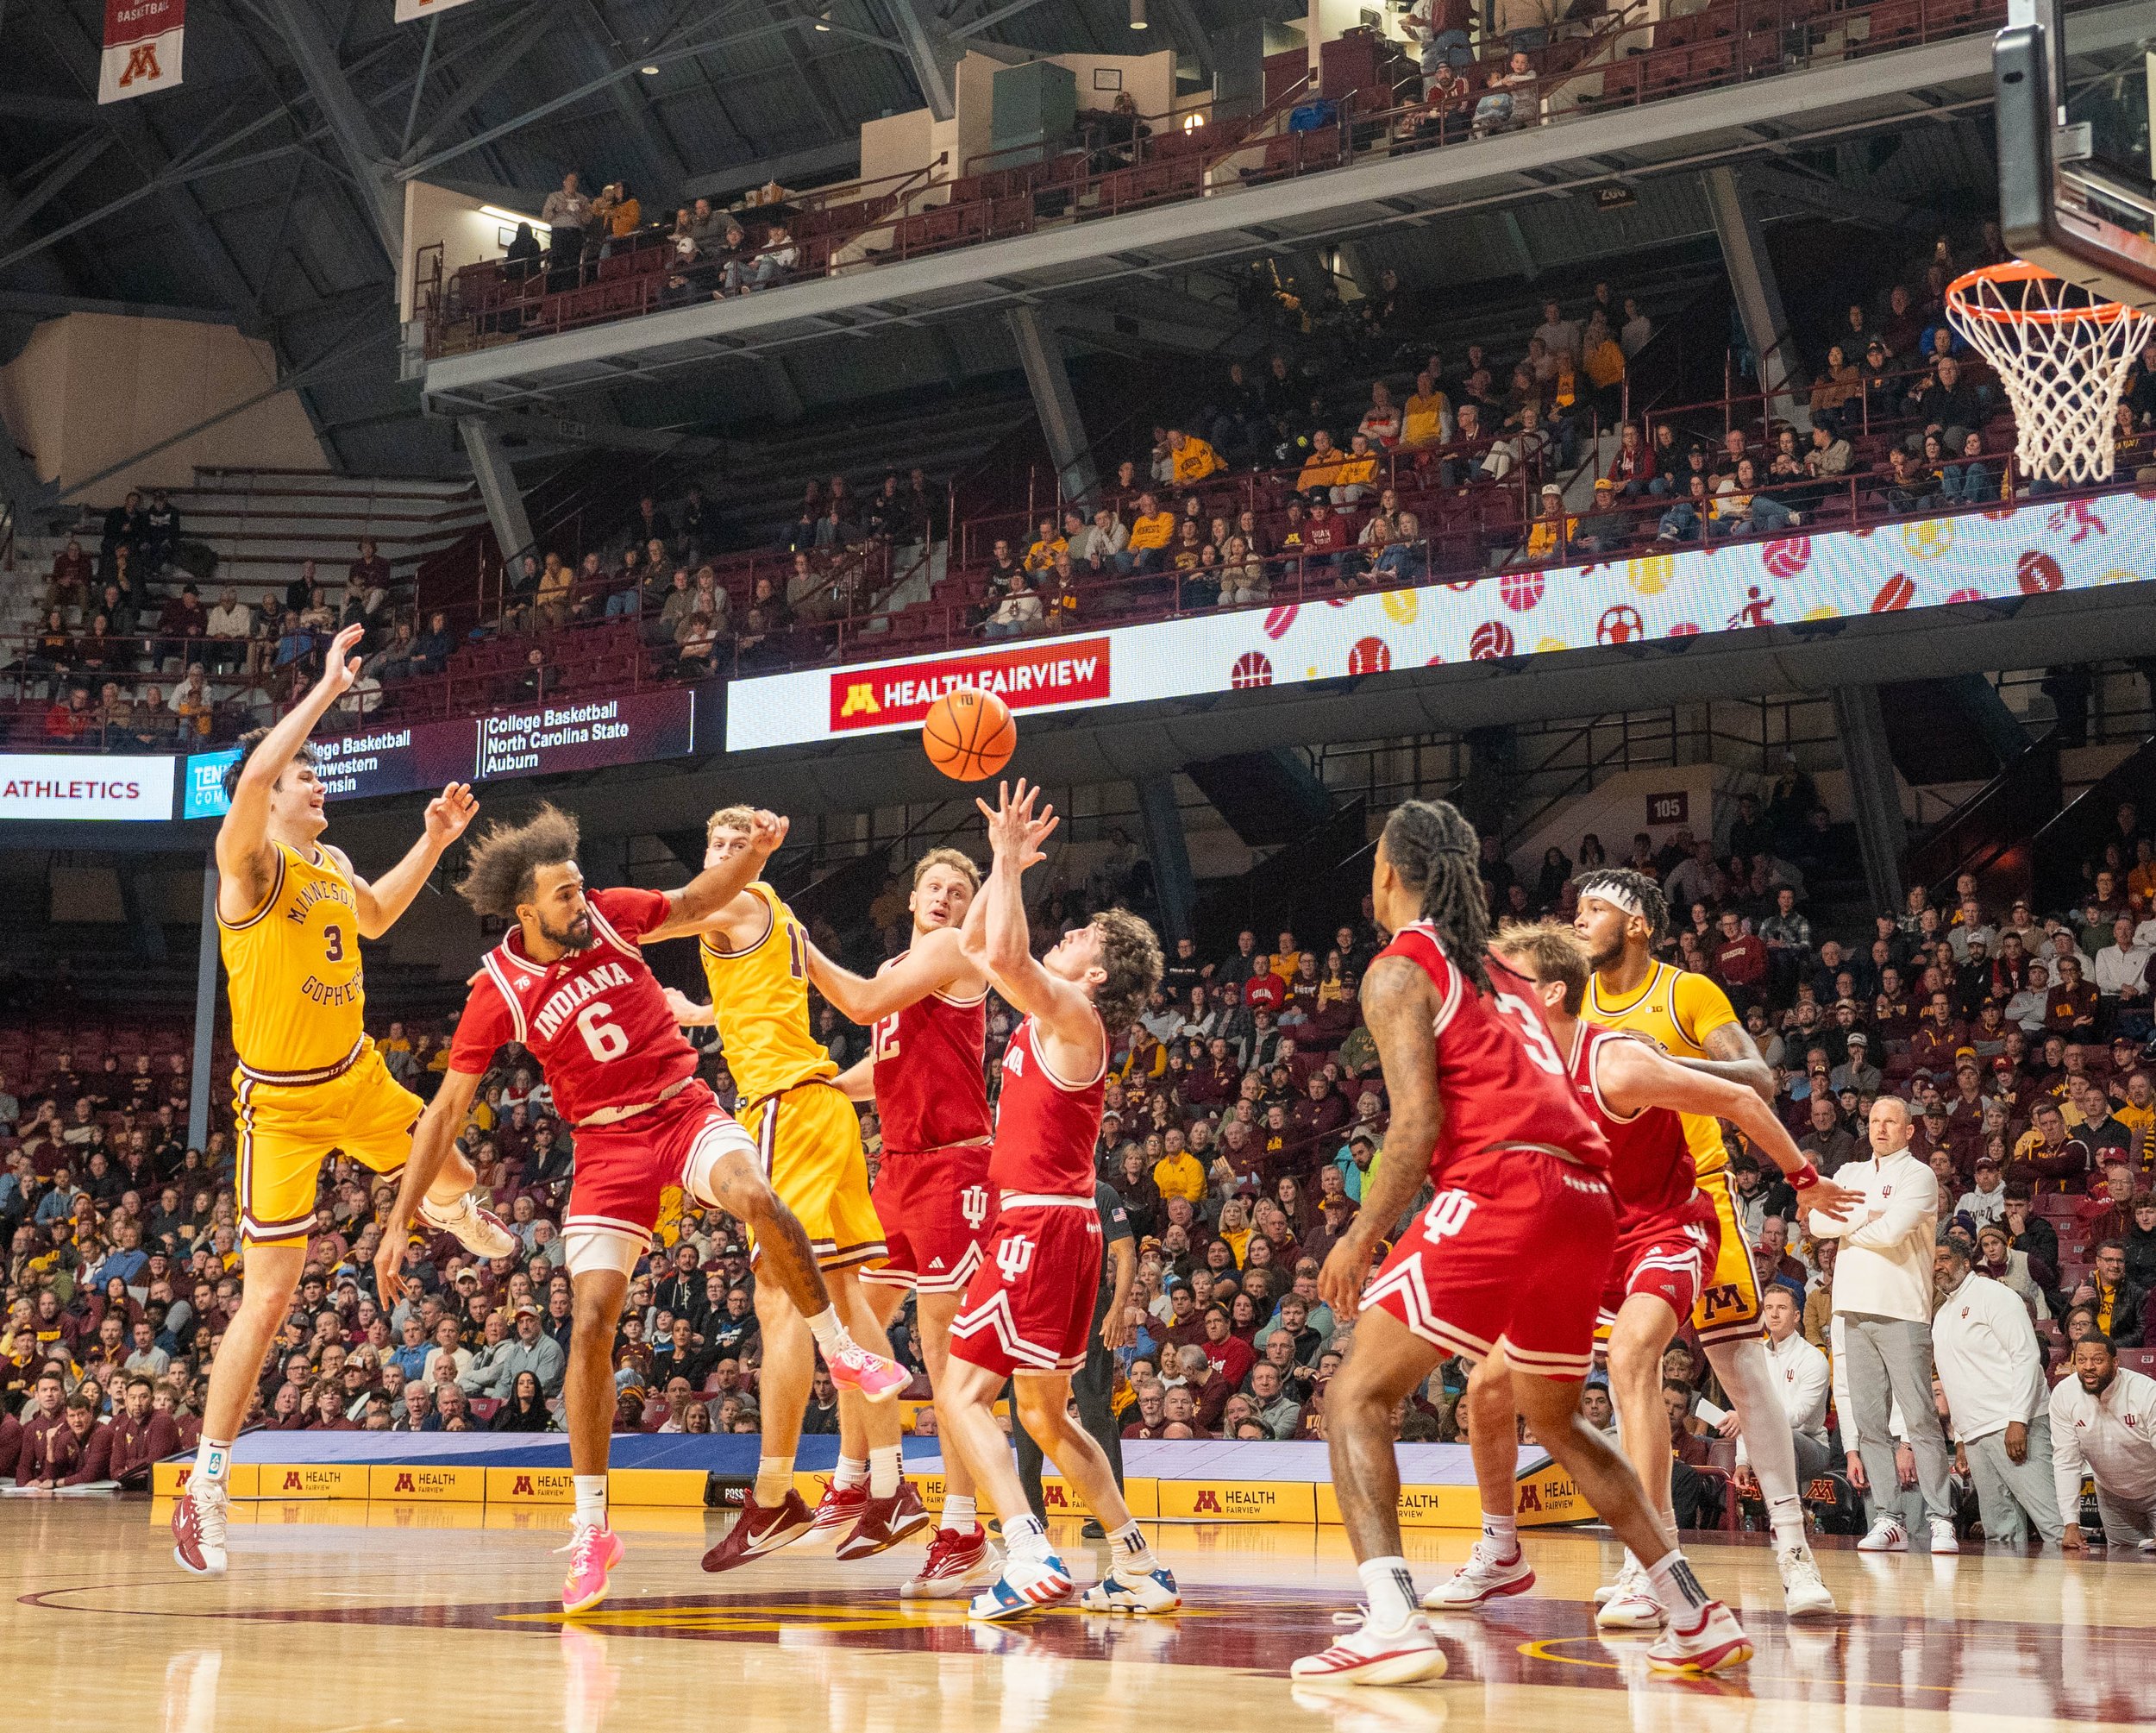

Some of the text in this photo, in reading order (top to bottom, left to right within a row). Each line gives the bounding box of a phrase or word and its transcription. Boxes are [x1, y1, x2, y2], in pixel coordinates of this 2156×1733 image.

[884, 673, 974, 707] HEALTH
[979, 656, 1097, 694] FAIRVIEW
[488, 700, 617, 733] College Basketball
[342, 730, 411, 755] Basketball
[487, 723, 630, 754] North Carolina State
[486, 753, 538, 772] Auburn
[3, 780, 140, 799] ATHLETICS
[1653, 799, 1681, 818] 105
[323, 925, 343, 964] 3
[513, 976, 531, 990] 76
[534, 962, 634, 1042] INDIANA
[577, 1001, 630, 1063] 6
[1495, 992, 1565, 1076] 3
[306, 1472, 341, 1483] HEALTH
[419, 1474, 455, 1485] HEALTH
[538, 1476, 574, 1487] HEALTH
[724, 1488, 744, 1500] POSS
[926, 1481, 947, 1494] HEA
[1225, 1491, 1275, 1504] HEALTH
[1398, 1495, 1438, 1508] EALTH
[1545, 1499, 1574, 1510] FAIRVIEW
